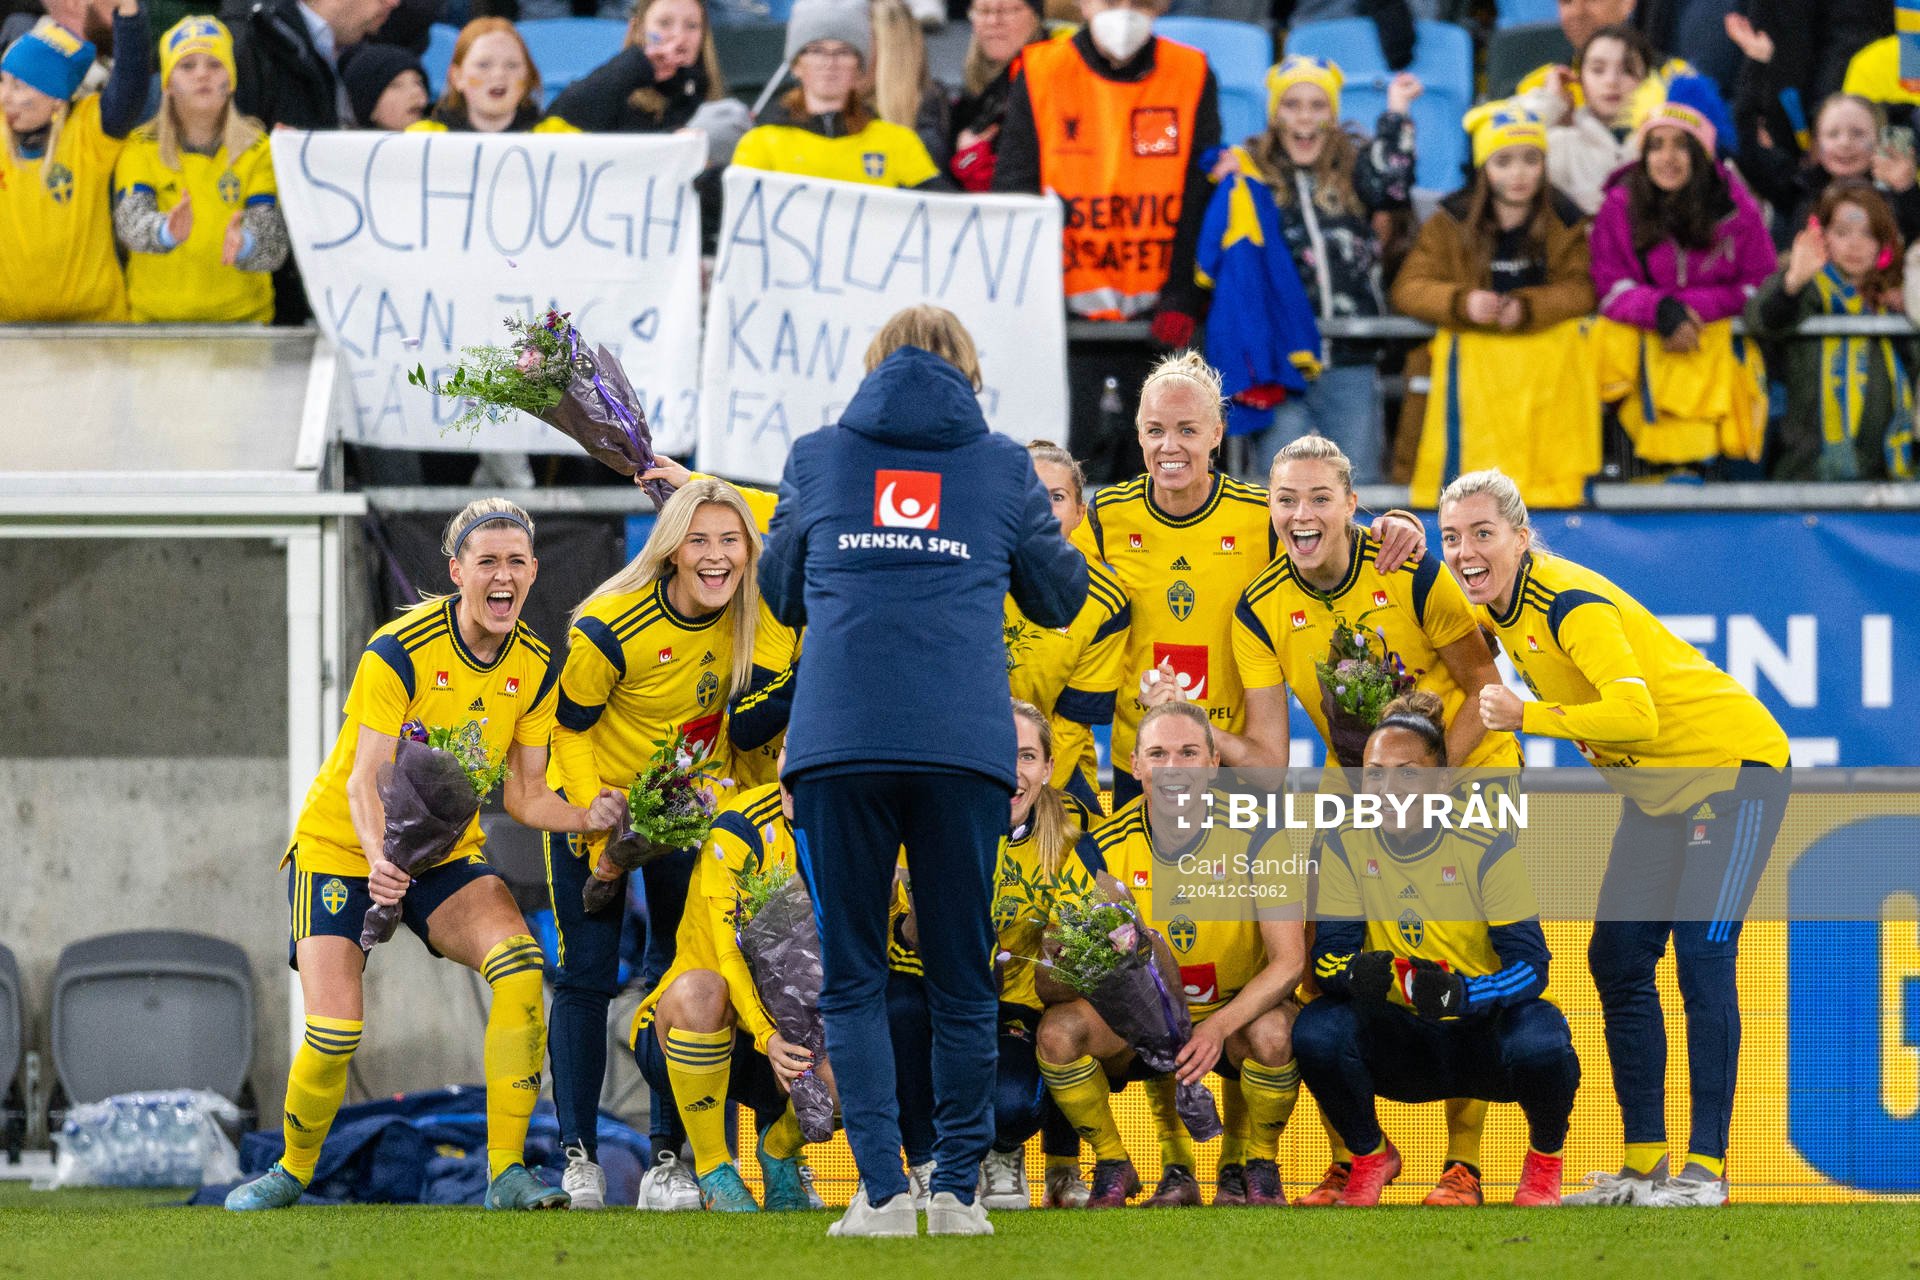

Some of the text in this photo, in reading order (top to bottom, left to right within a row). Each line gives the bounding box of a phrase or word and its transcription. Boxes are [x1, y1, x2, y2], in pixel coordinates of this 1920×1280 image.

[300, 130, 686, 259] SCHOUGH
[1069, 194, 1179, 230] SERVIC
[718, 177, 1043, 307] ASLLANI
[1081, 237, 1173, 272] SAFET
[325, 285, 454, 359] KAN
[728, 296, 851, 384] KAN
[838, 533, 972, 560] SVENSKA SPEL
